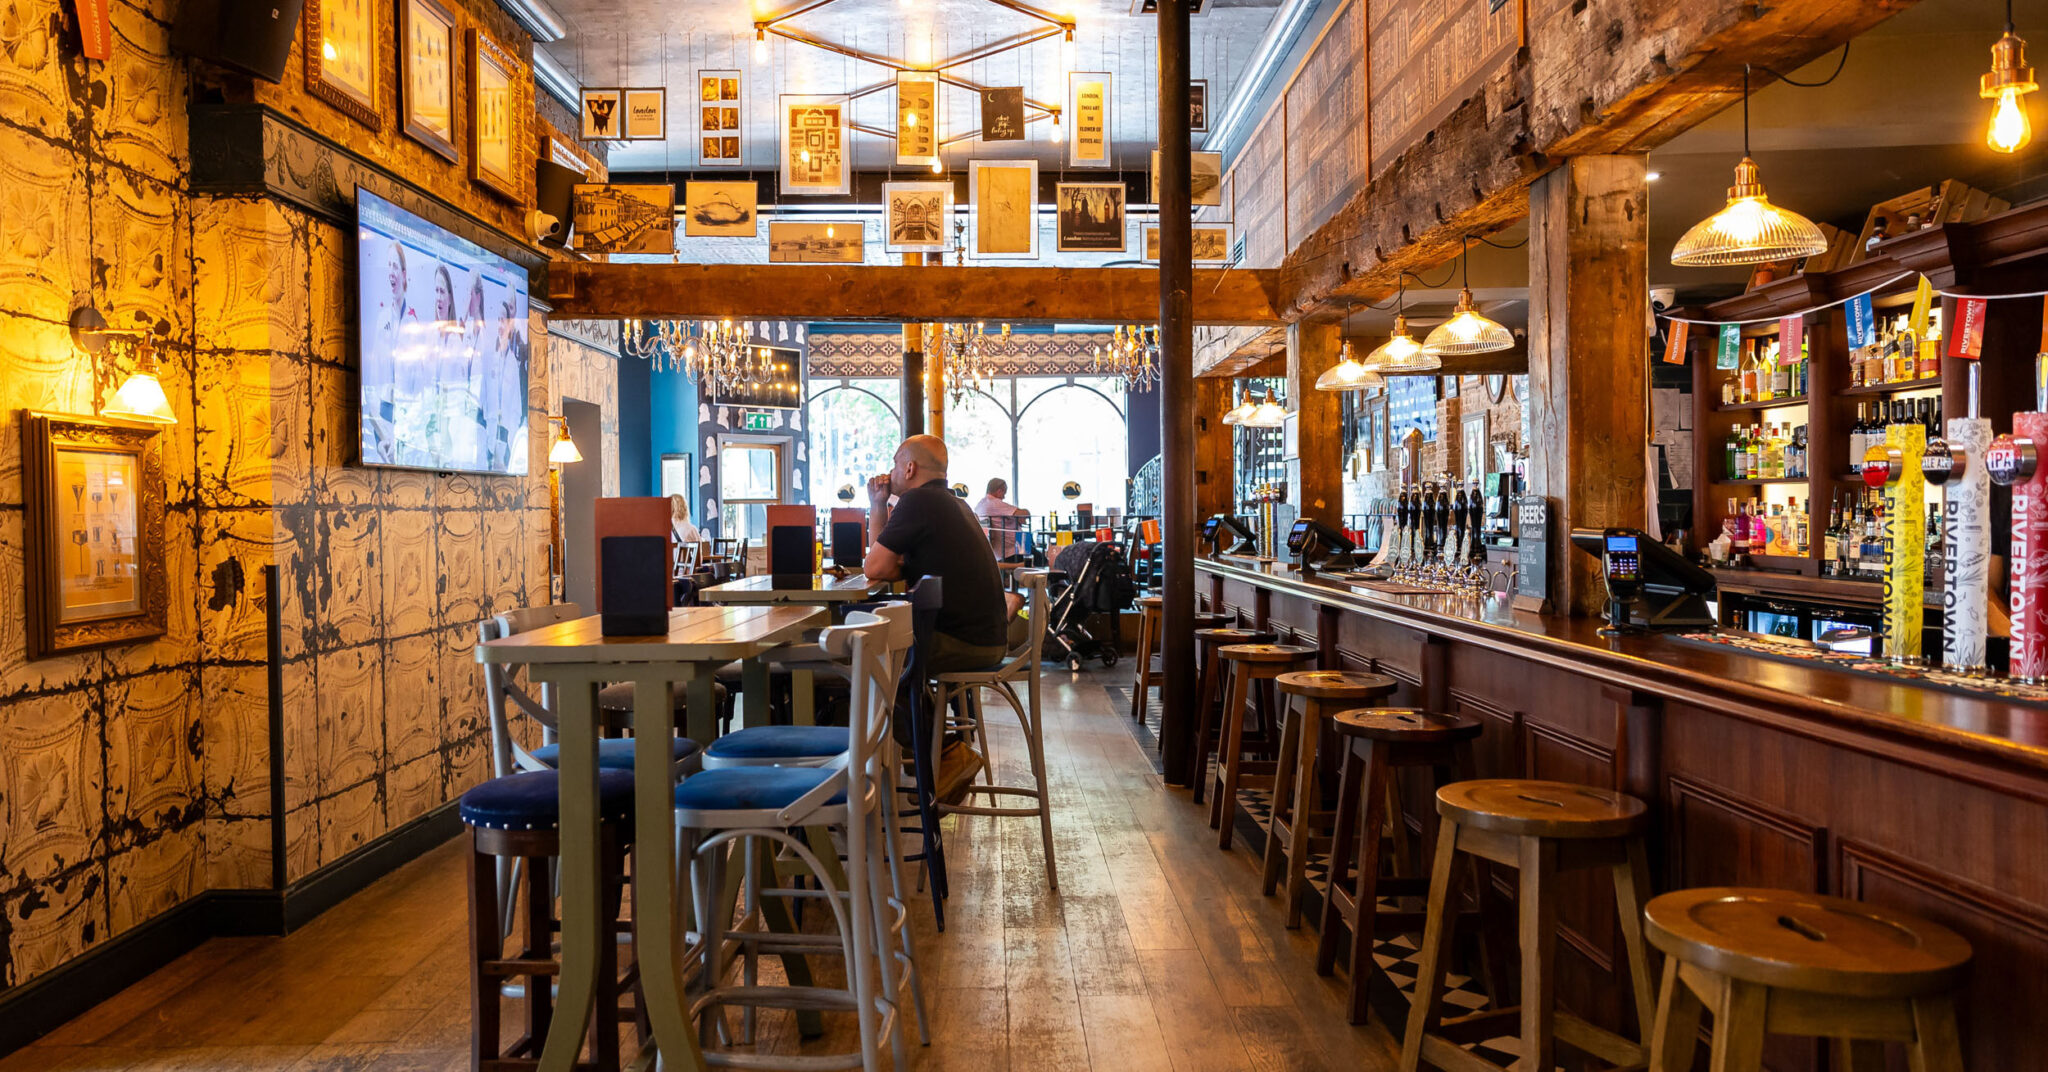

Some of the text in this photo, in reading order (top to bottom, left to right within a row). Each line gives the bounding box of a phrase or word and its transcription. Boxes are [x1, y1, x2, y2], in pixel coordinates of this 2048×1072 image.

[1853, 298, 1864, 345] RIVERTOWN
[1960, 300, 1974, 354] RIVERTOWN
[1991, 452, 2011, 468] IPA
[1519, 505, 1546, 524] BEERS
[1883, 497, 1895, 639] RIVERTOWN
[1944, 501, 1959, 653] RIVERTOWN
[2010, 495, 2029, 660] RIVERTOWN
